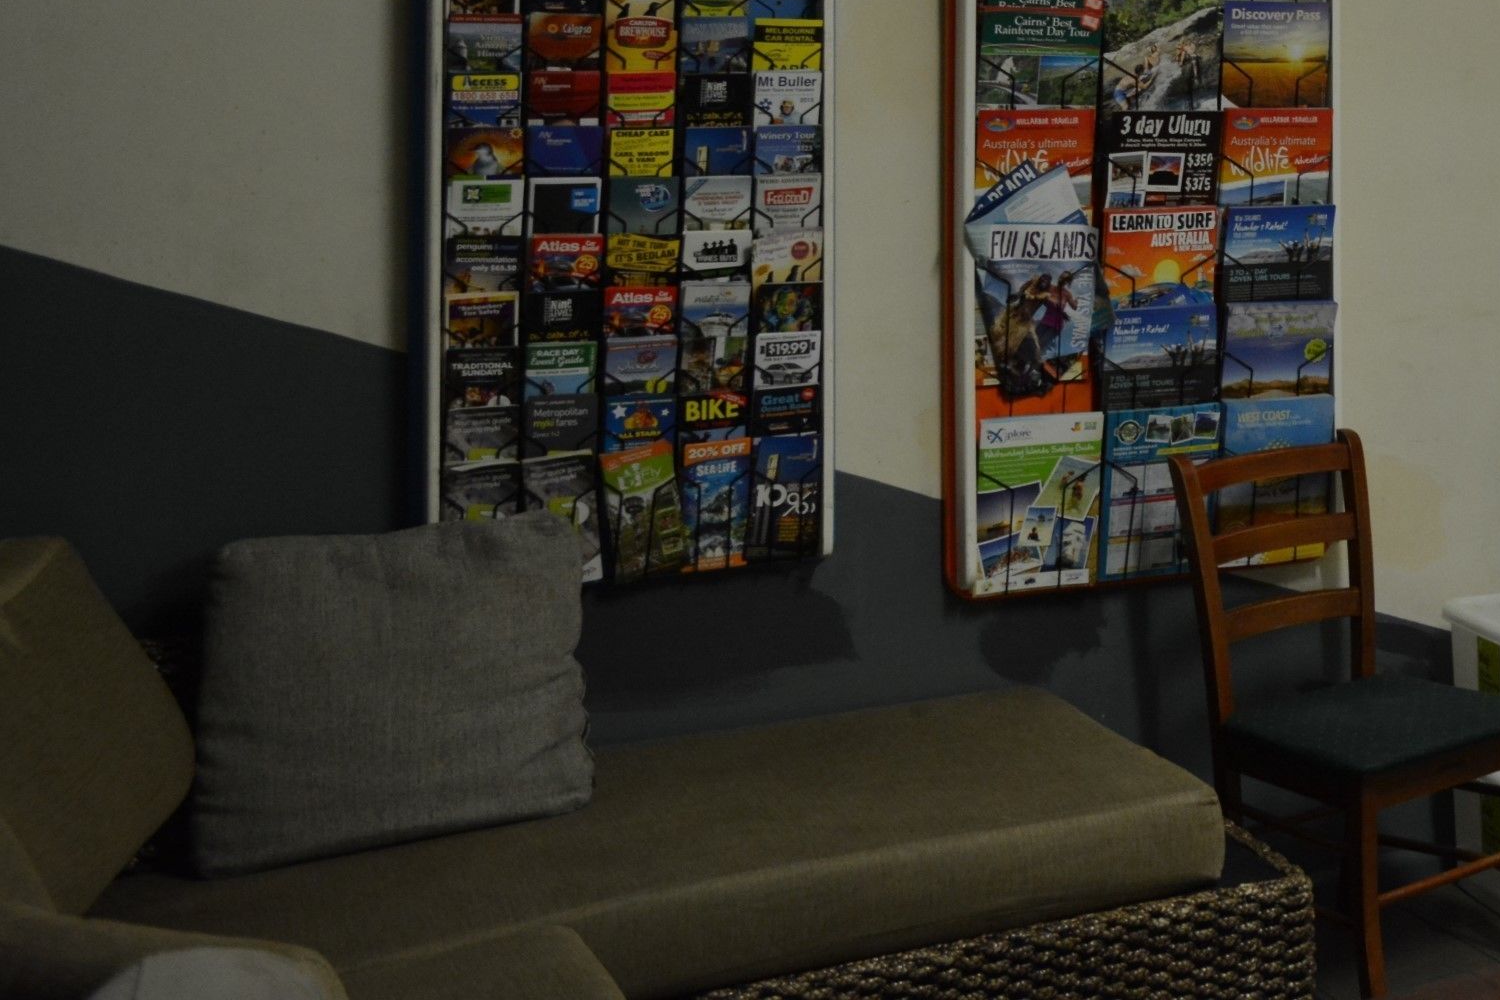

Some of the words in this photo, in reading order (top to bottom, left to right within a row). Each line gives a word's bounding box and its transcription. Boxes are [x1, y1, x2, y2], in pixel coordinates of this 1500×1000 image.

[1014, 15, 1050, 27] Cairns'
[1053, 17, 1072, 27] Best
[1231, 8, 1294, 23] Discovery
[1296, 10, 1320, 20] Pass
[562, 24, 592, 35] Calypso
[620, 26, 667, 37] BREWHOUSE
[994, 25, 1043, 36] Rainforest
[1046, 26, 1065, 38] Day
[1069, 28, 1090, 37] Tour
[758, 76, 774, 87] Mt
[778, 76, 817, 87] Buller
[1120, 115, 1131, 135] 3
[1135, 115, 1164, 137] day
[760, 132, 792, 141] Winery
[795, 131, 817, 139] Tour
[1231, 136, 1277, 146] Australia's
[1279, 135, 1316, 146] ultimate
[983, 138, 1036, 149] Australia's
[1038, 138, 1078, 149] ultimate
[1230, 145, 1290, 177] Wildlife
[1185, 177, 1211, 192] $375
[1113, 214, 1154, 231] LEARN
[1157, 214, 1174, 230] TO
[1177, 212, 1213, 229] SURF
[1233, 221, 1260, 232] Number
[990, 230, 1018, 259] FIJI
[1022, 231, 1097, 259] ISLANDS
[1151, 231, 1210, 247] AUSTRALIA
[456, 243, 493, 251] penguins
[538, 240, 580, 252] Atlas
[615, 253, 633, 262] IT'S
[637, 249, 676, 260] BEDLAM
[471, 264, 489, 272] only
[612, 292, 654, 304] Atlas
[1113, 325, 1140, 336] Number
[562, 349, 579, 357] DAY
[768, 341, 808, 356] $19.99
[452, 362, 513, 370] TRADITIONAL
[530, 357, 556, 366] Event
[558, 356, 585, 367] Guide
[461, 369, 503, 377] SUNDAYS
[761, 393, 799, 406] Great
[534, 408, 588, 417] Metropolitan
[685, 398, 740, 422] BIKE
[1262, 409, 1291, 420] COAST
[556, 418, 578, 427] fares
[688, 446, 718, 458] 20%
[721, 443, 745, 455] OFF
